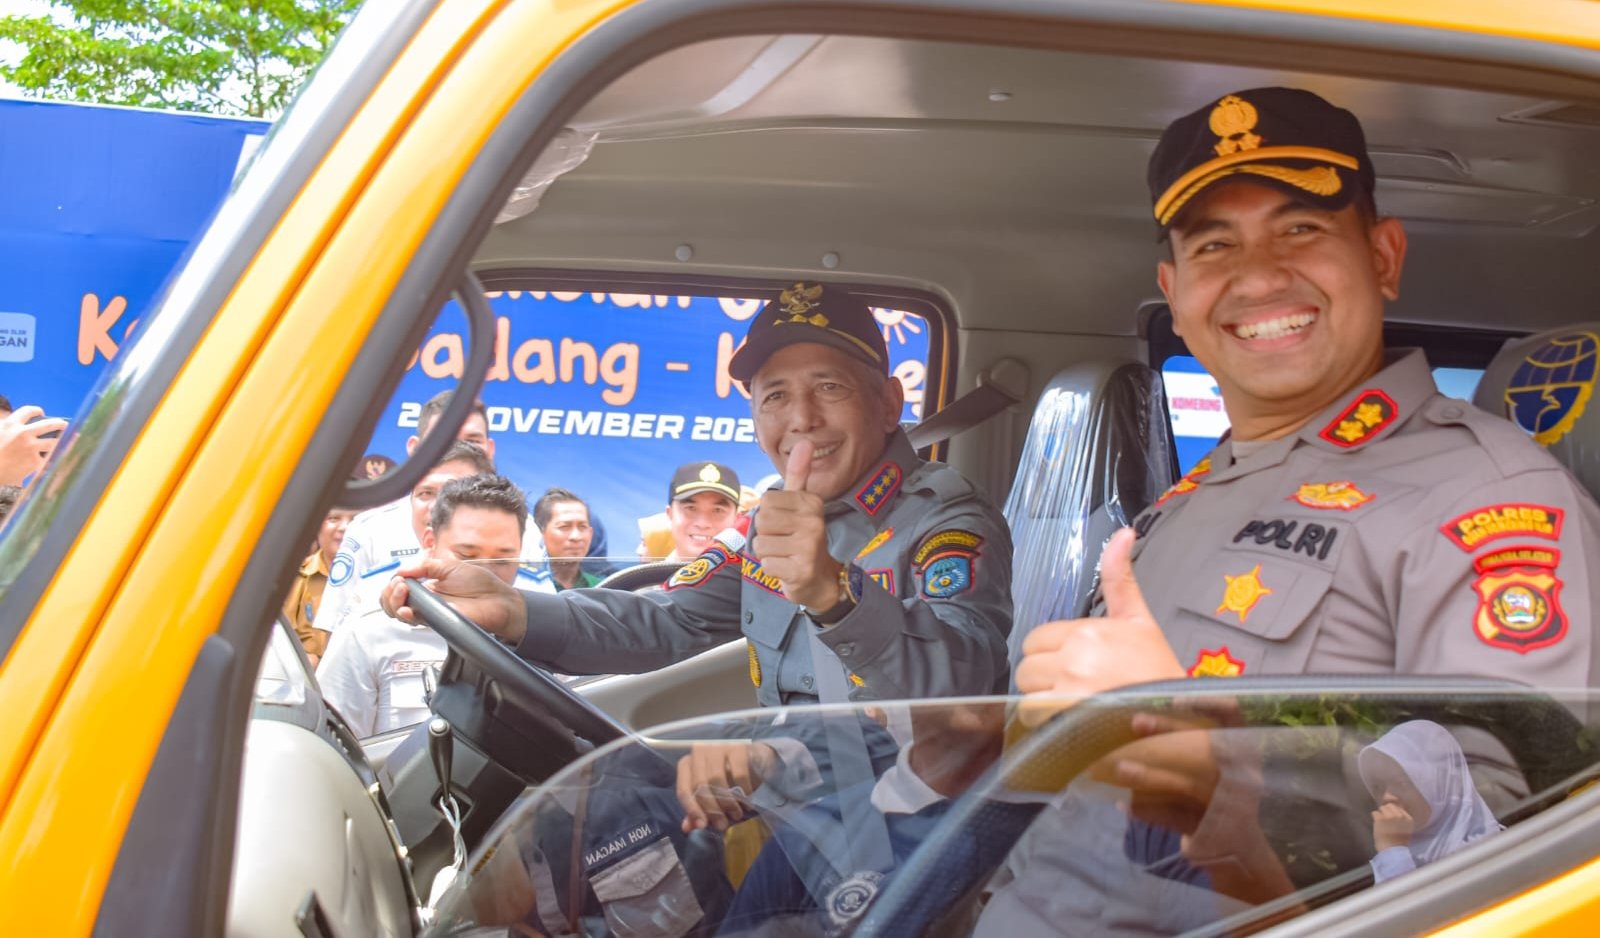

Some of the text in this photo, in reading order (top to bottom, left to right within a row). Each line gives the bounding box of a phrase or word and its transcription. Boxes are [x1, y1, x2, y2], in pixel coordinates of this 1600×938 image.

[405, 315, 641, 407] adang
[485, 406, 685, 440] OVEMBER
[690, 416, 760, 444] 202
[1232, 518, 1338, 561] POLRI
[1457, 506, 1549, 535] POLRES
